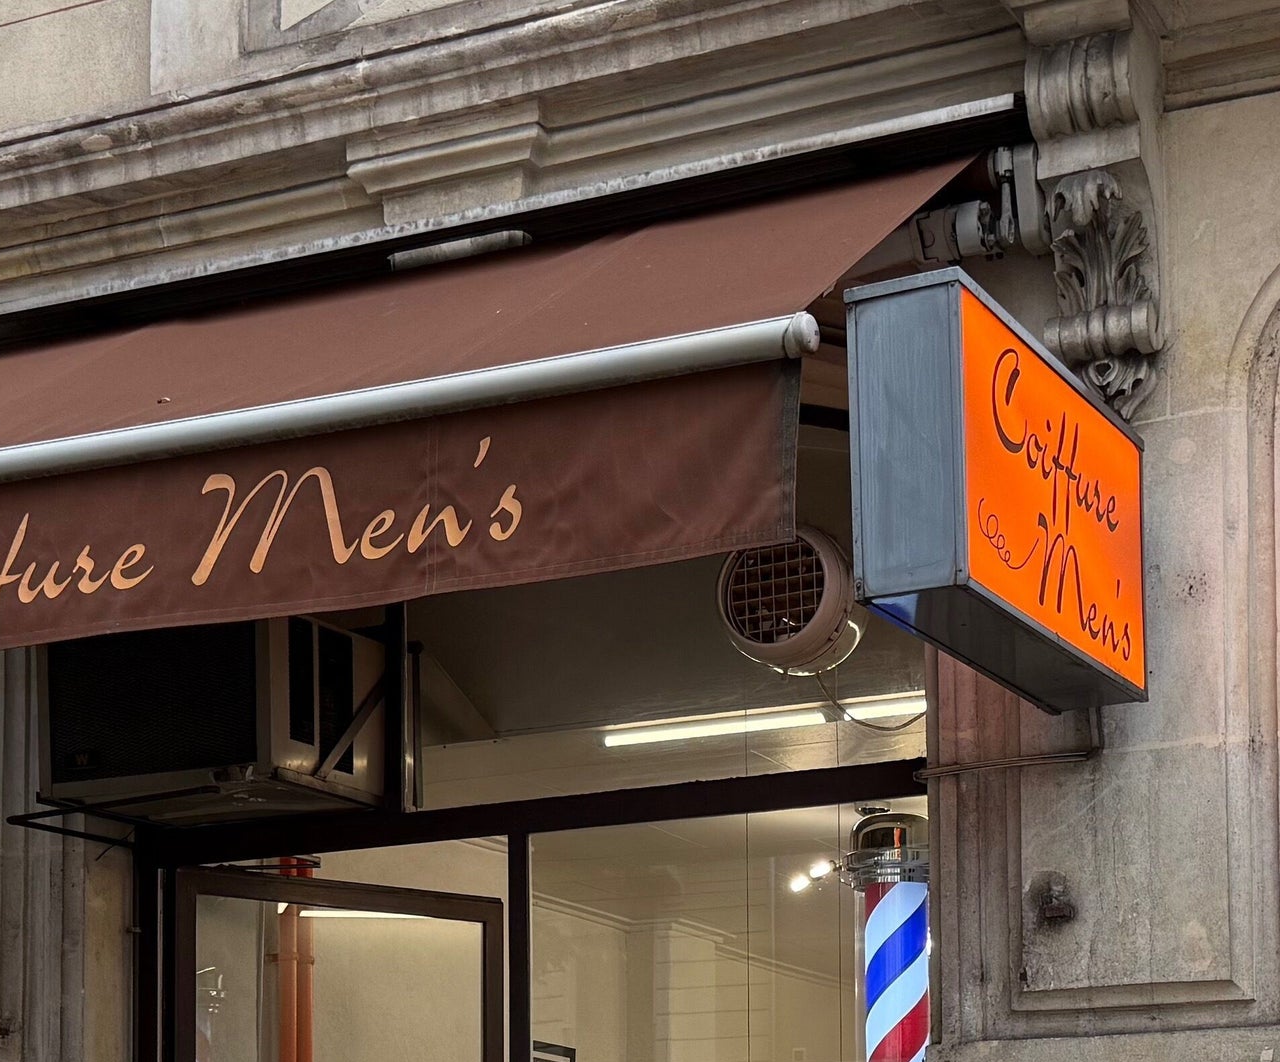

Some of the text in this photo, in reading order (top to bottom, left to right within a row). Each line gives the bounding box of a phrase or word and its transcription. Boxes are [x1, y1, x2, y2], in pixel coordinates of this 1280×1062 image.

[191, 436, 524, 586] Men's
[991, 348, 1119, 536] Coiffure
[1037, 511, 1131, 661] Men's
